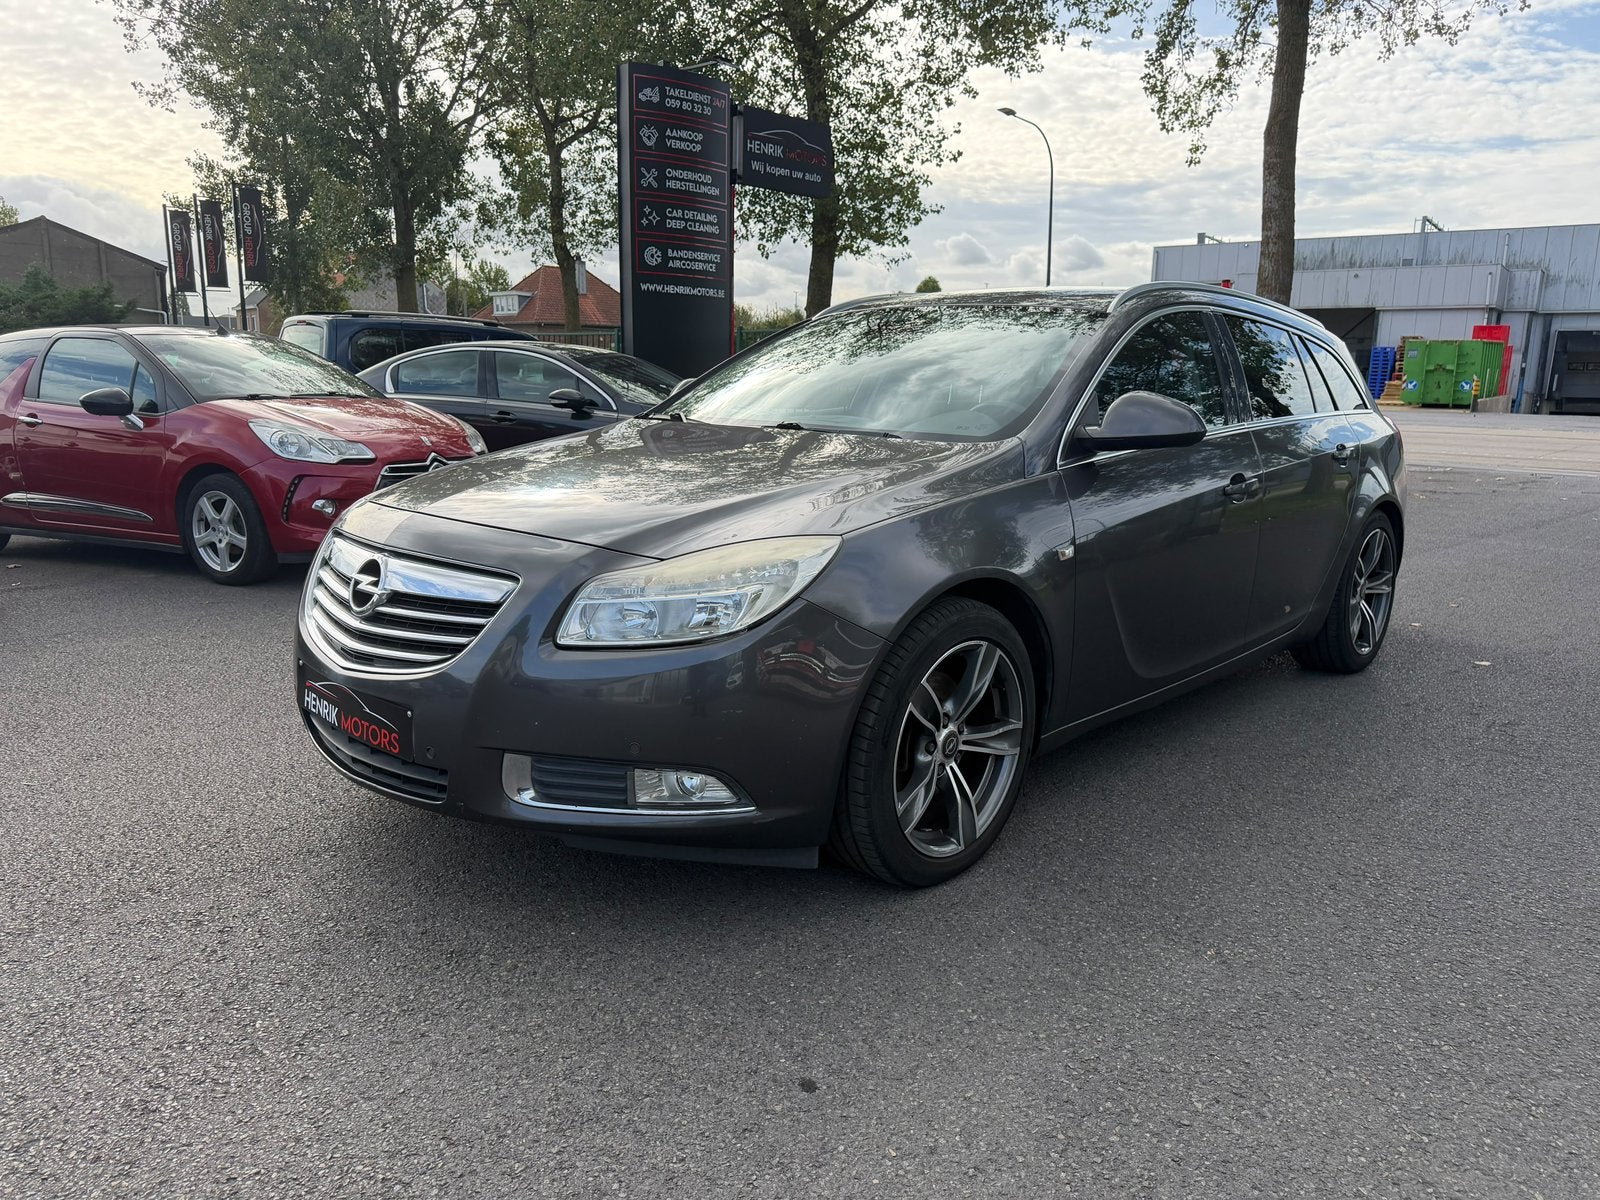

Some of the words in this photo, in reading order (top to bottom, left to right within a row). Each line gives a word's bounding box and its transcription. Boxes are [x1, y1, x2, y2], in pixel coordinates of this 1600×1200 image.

[665, 86, 712, 104] TAKELDIENST
[712, 98, 726, 109] 24/7
[665, 98, 680, 108] 059
[682, 102, 692, 111] 80
[693, 103, 702, 113] 32
[703, 106, 712, 115] 30
[665, 128, 704, 141] AANKOOP
[665, 138, 702, 152] VERKOOP
[747, 139, 784, 158] HENRIK
[666, 168, 712, 184] ONDERHOUD
[751, 160, 764, 174] Wij
[766, 164, 790, 177] kopen
[792, 170, 803, 179] uw
[804, 172, 822, 182] auto
[666, 180, 720, 196] HERSTELLINGEN
[242, 202, 252, 235] GROUP
[666, 208, 683, 218] CAR
[684, 210, 718, 223] DETAILING
[203, 213, 213, 241] HENRIK
[666, 219, 686, 230] DEEP
[687, 221, 720, 234] CLEANING
[172, 222, 182, 251] GROUP
[206, 241, 216, 274] MOTORS
[245, 236, 255, 267] HENRIK
[668, 248, 721, 263] BANDENSERVICE
[668, 260, 716, 272] AIRCOSERVICE
[640, 282, 725, 298] WWW.HENRIKMOTORS.BE
[304, 688, 339, 726] HENRIK
[341, 711, 399, 754] MOTORS
